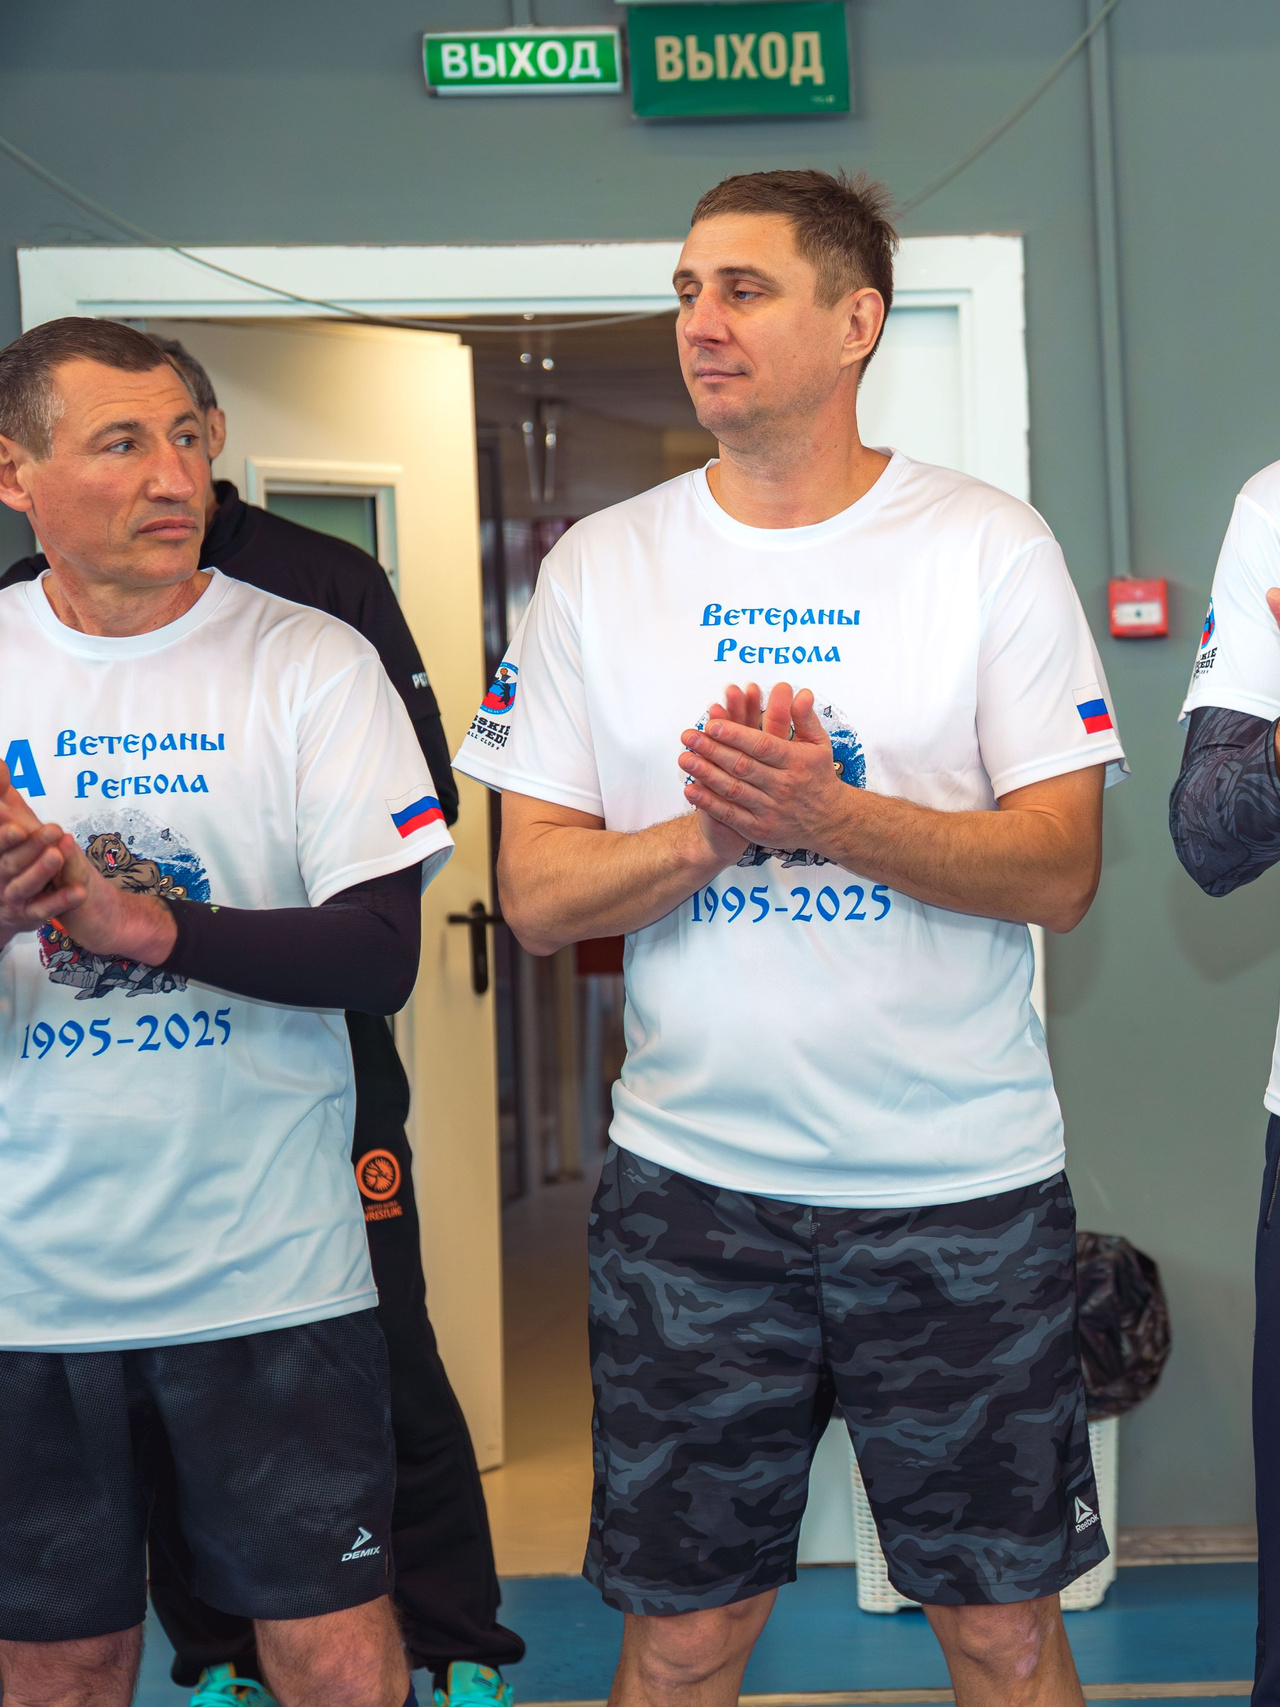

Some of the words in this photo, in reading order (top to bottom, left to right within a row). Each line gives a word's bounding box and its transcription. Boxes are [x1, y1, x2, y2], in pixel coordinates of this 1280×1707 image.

[441, 40, 602, 80] ВЫХОД
[655, 31, 825, 86] ВЫХОД
[699, 603, 861, 633] Ветераны
[714, 638, 842, 665] Регбола
[54, 729, 227, 761] Ветераны
[74, 770, 211, 800] Регбола
[691, 884, 893, 925] 1995-2025
[20, 1007, 233, 1061] 1995-2025
[1075, 1513, 1099, 1533] Reebok
[341, 1545, 381, 1562] DEMIX
